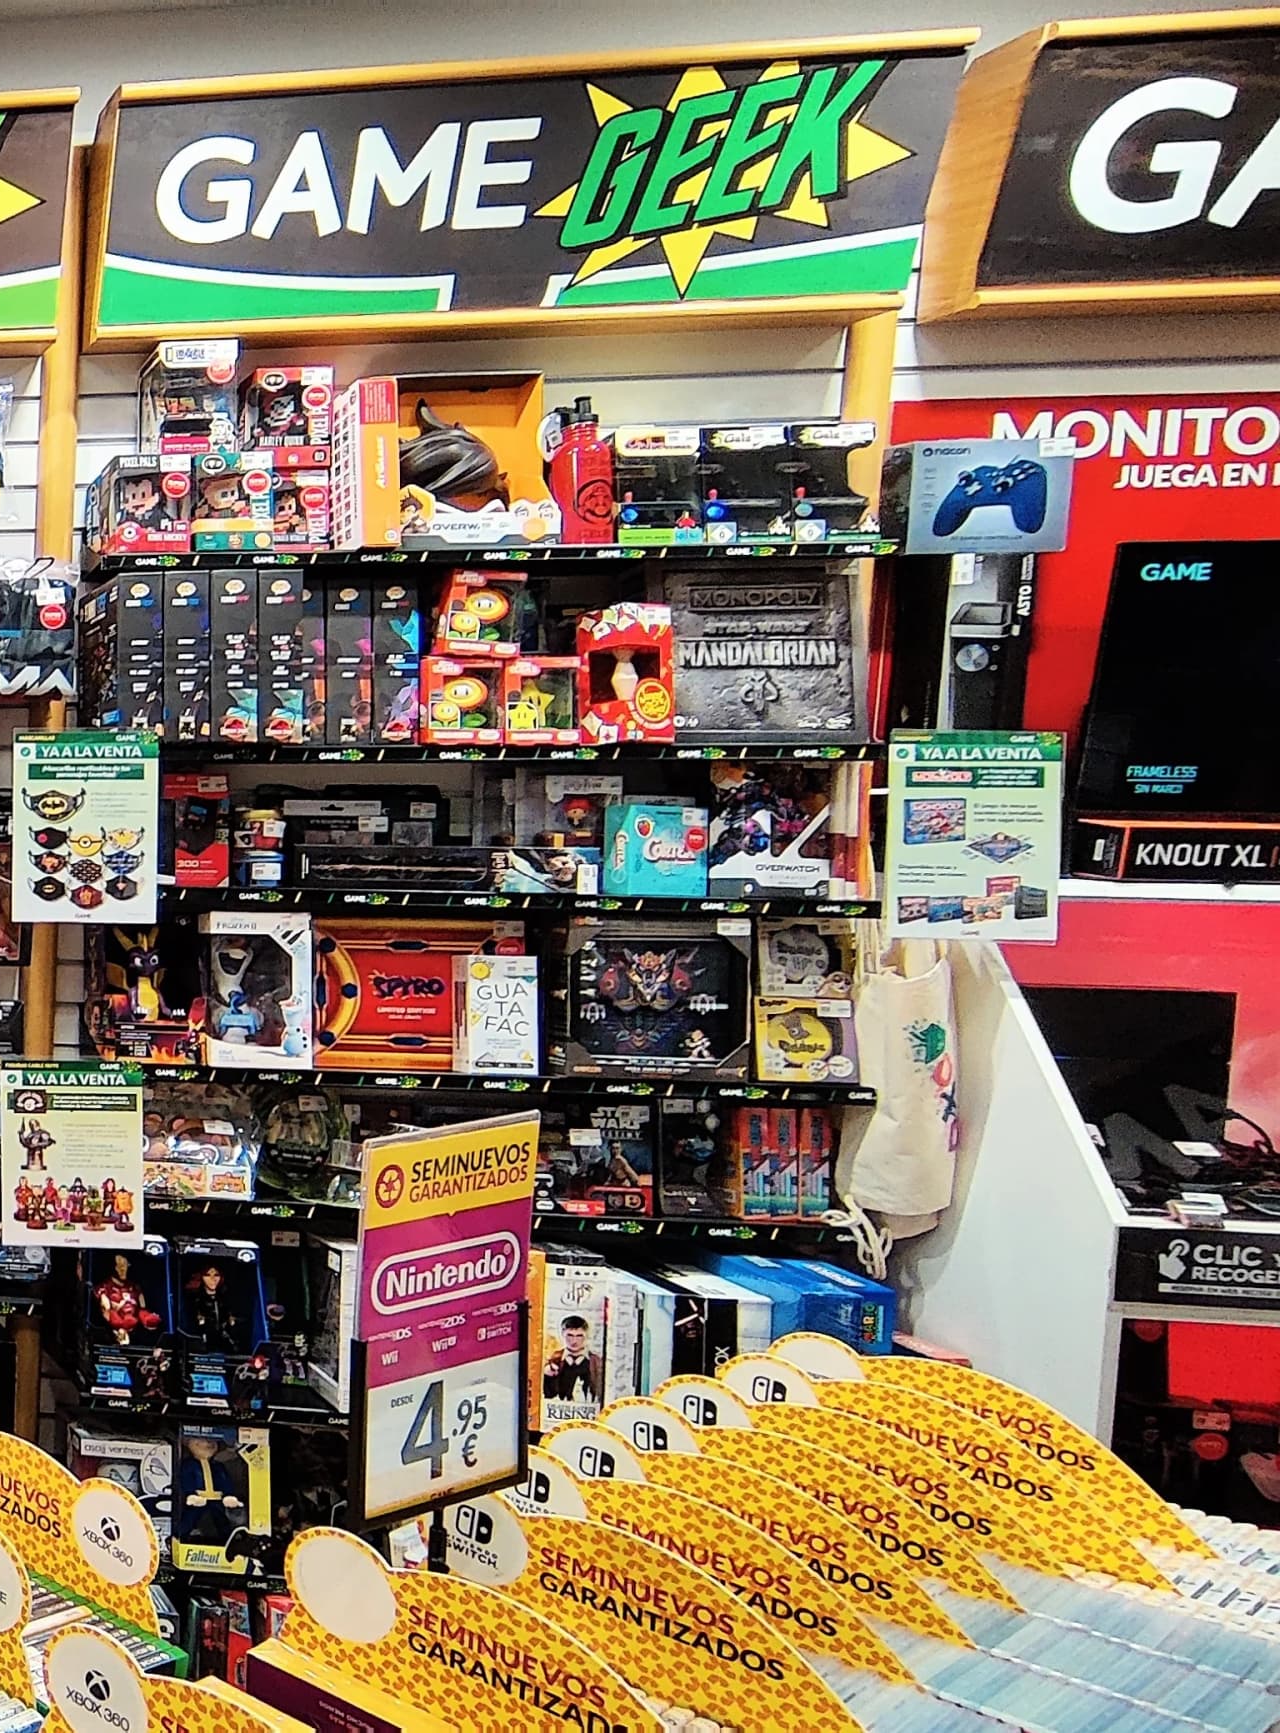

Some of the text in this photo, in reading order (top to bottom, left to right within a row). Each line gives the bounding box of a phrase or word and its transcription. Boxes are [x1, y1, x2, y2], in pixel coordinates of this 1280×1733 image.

[155, 60, 887, 248] GAME GEEK
[120, 456, 157, 468] PIXEL PALS
[1114, 463, 1265, 489] JUEGA EN
[1141, 563, 1213, 581] GAME
[692, 587, 819, 607] MONOPOLY
[703, 621, 809, 634] STAR WARS
[679, 640, 836, 666] MANDALORIAN
[42, 745, 142, 757] YA A LA VENTA
[921, 747, 1043, 760] YA A LA VENTA
[1127, 766, 1197, 779] FRAMELESS
[1134, 784, 1149, 793] SIN
[1136, 843, 1267, 867] KNOUT XL
[756, 864, 820, 873] OVERWATCH
[372, 976, 444, 998] SPYRO
[477, 982, 528, 1001] GUA
[377, 1006, 436, 1015] LIMITED EDITION
[496, 1000, 525, 1017] TA
[484, 1016, 530, 1036] FAC
[27, 1074, 126, 1085] YA A LA VENTA
[411, 1141, 531, 1183] SEMINUEVOS
[409, 1166, 529, 1203] GARANTIZADOS
[1193, 1244, 1262, 1266] CLIC
[385, 1248, 507, 1300] Nintendo
[1192, 1267, 1280, 1283] RECOGE
[381, 1349, 399, 1366] Wii
[391, 1394, 414, 1408] DESDE
[547, 1408, 595, 1420] RISING
[81, 1526, 134, 1567] XBOX 360
[185, 1549, 220, 1565] Fallout
[540, 1547, 737, 1637] SEMINUEVOS
[539, 1571, 786, 1681] GARANTIZADOS
[408, 1605, 607, 1709] SEMINUEVOS
[407, 1632, 629, 1733] GARANTIZAD
[64, 1688, 132, 1733] XBOX 360
